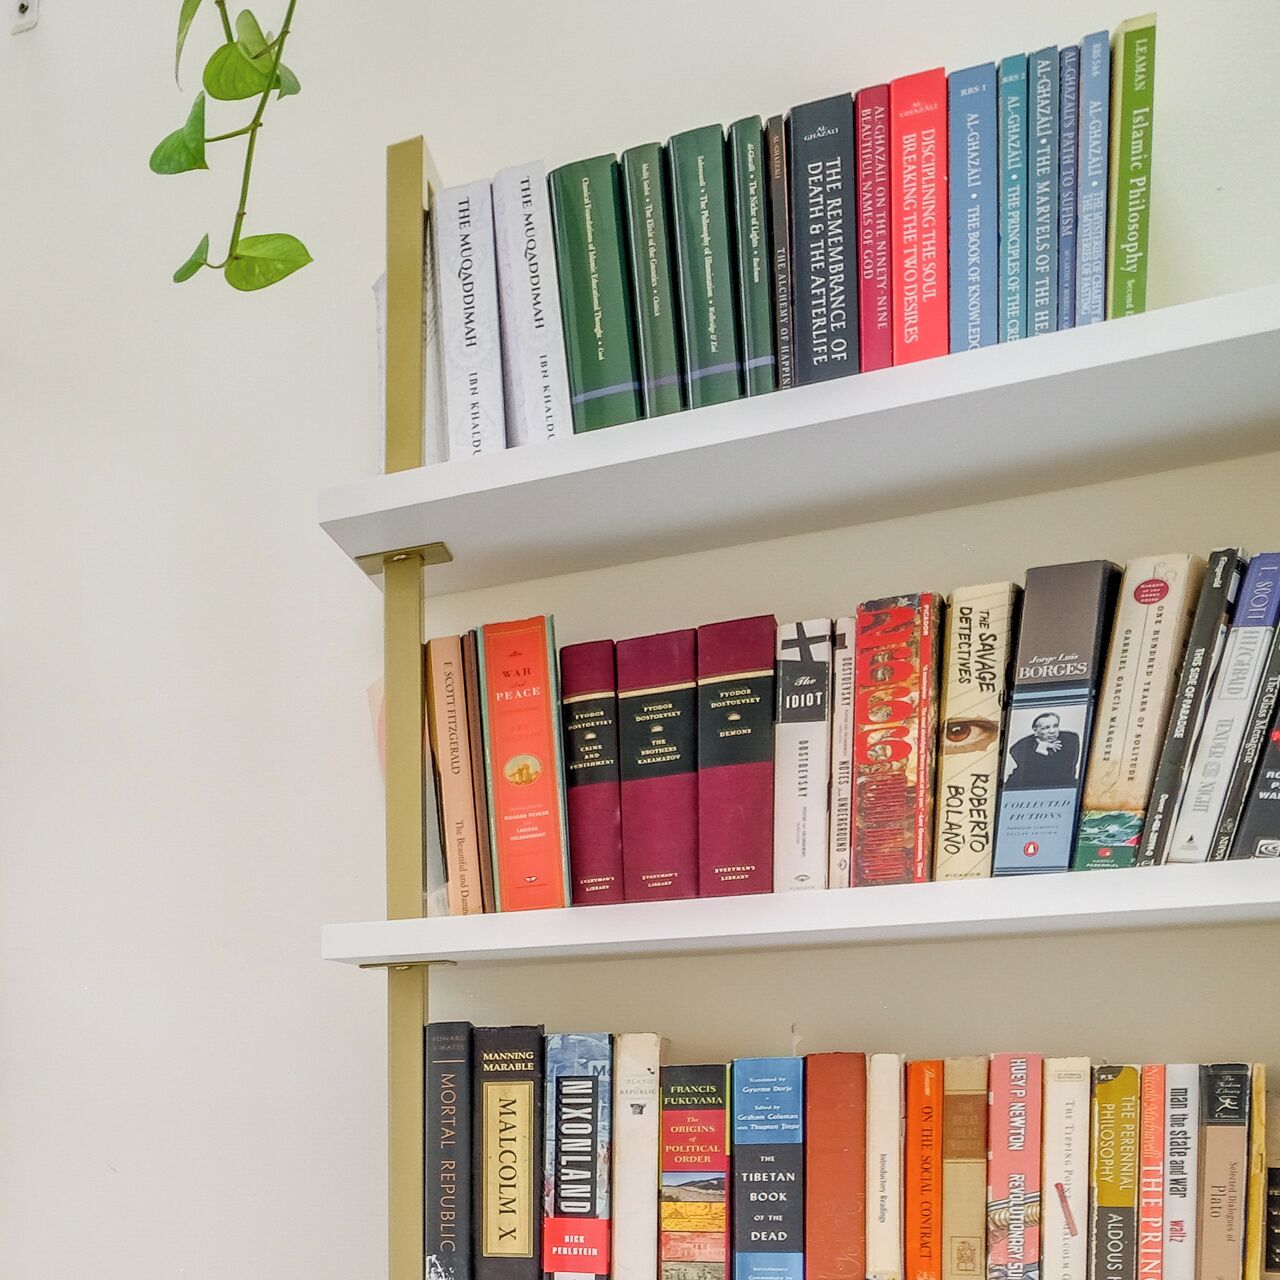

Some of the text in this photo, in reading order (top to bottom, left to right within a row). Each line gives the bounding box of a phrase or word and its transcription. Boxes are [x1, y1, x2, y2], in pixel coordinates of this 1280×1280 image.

[1134, 39, 1148, 91] LEAMAN
[1120, 108, 1150, 274] Islamic Philosophy
[921, 129, 936, 301] DISCIPLINING THE SOUL
[520, 176, 544, 329] THE MUQADDIMAH
[826, 157, 847, 361] THE REMEMBRANCE OF
[903, 134, 918, 344] BREAKING THE TWO DESIRES
[458, 196, 477, 349] THE MUQADDIMAH
[958, 607, 973, 684] DETECTIVES
[979, 611, 996, 694] THE SAVAGE
[1029, 654, 1056, 664] Jorge
[502, 666, 531, 679] WAR
[1018, 662, 1088, 679] BORGES
[496, 687, 541, 701] PEACE
[710, 697, 761, 709] DOSTOEVSKY
[720, 688, 752, 698] FYODOR
[785, 692, 823, 709] IDIOT
[720, 728, 752, 737] DEMONS
[968, 774, 990, 852] ROBERTO
[483, 1051, 534, 1061] MANNING
[484, 1061, 534, 1072] MARABLE
[664, 1096, 723, 1105] FUKUYAMA
[670, 1085, 717, 1094] FRANCIS
[559, 1080, 593, 1214] NIXONLAND
[665, 1145, 721, 1153] POLITICAL
[670, 1124, 715, 1133] ORIGINS
[1100, 1103, 1115, 1184] PHILOSOPHY
[1120, 1096, 1135, 1191] THE PERENNIAL
[1169, 1088, 1191, 1198] man the state and war
[440, 1072, 455, 1253] MORTAL REPUBLIC
[498, 1097, 517, 1240] MALCOLM X
[674, 1155, 711, 1163] ORDER
[741, 1173, 795, 1182] TIBETAN
[750, 1192, 787, 1201] BOOK
[920, 1106, 932, 1260] ON THE SOCIAL CONTRACT
[1142, 1165, 1162, 1207] THE
[1210, 1185, 1226, 1218] Plato
[751, 1232, 788, 1241] DEAD
[1009, 1174, 1024, 1259] REVOLUTIONARY
[1107, 1213, 1123, 1268] ALDOUS
